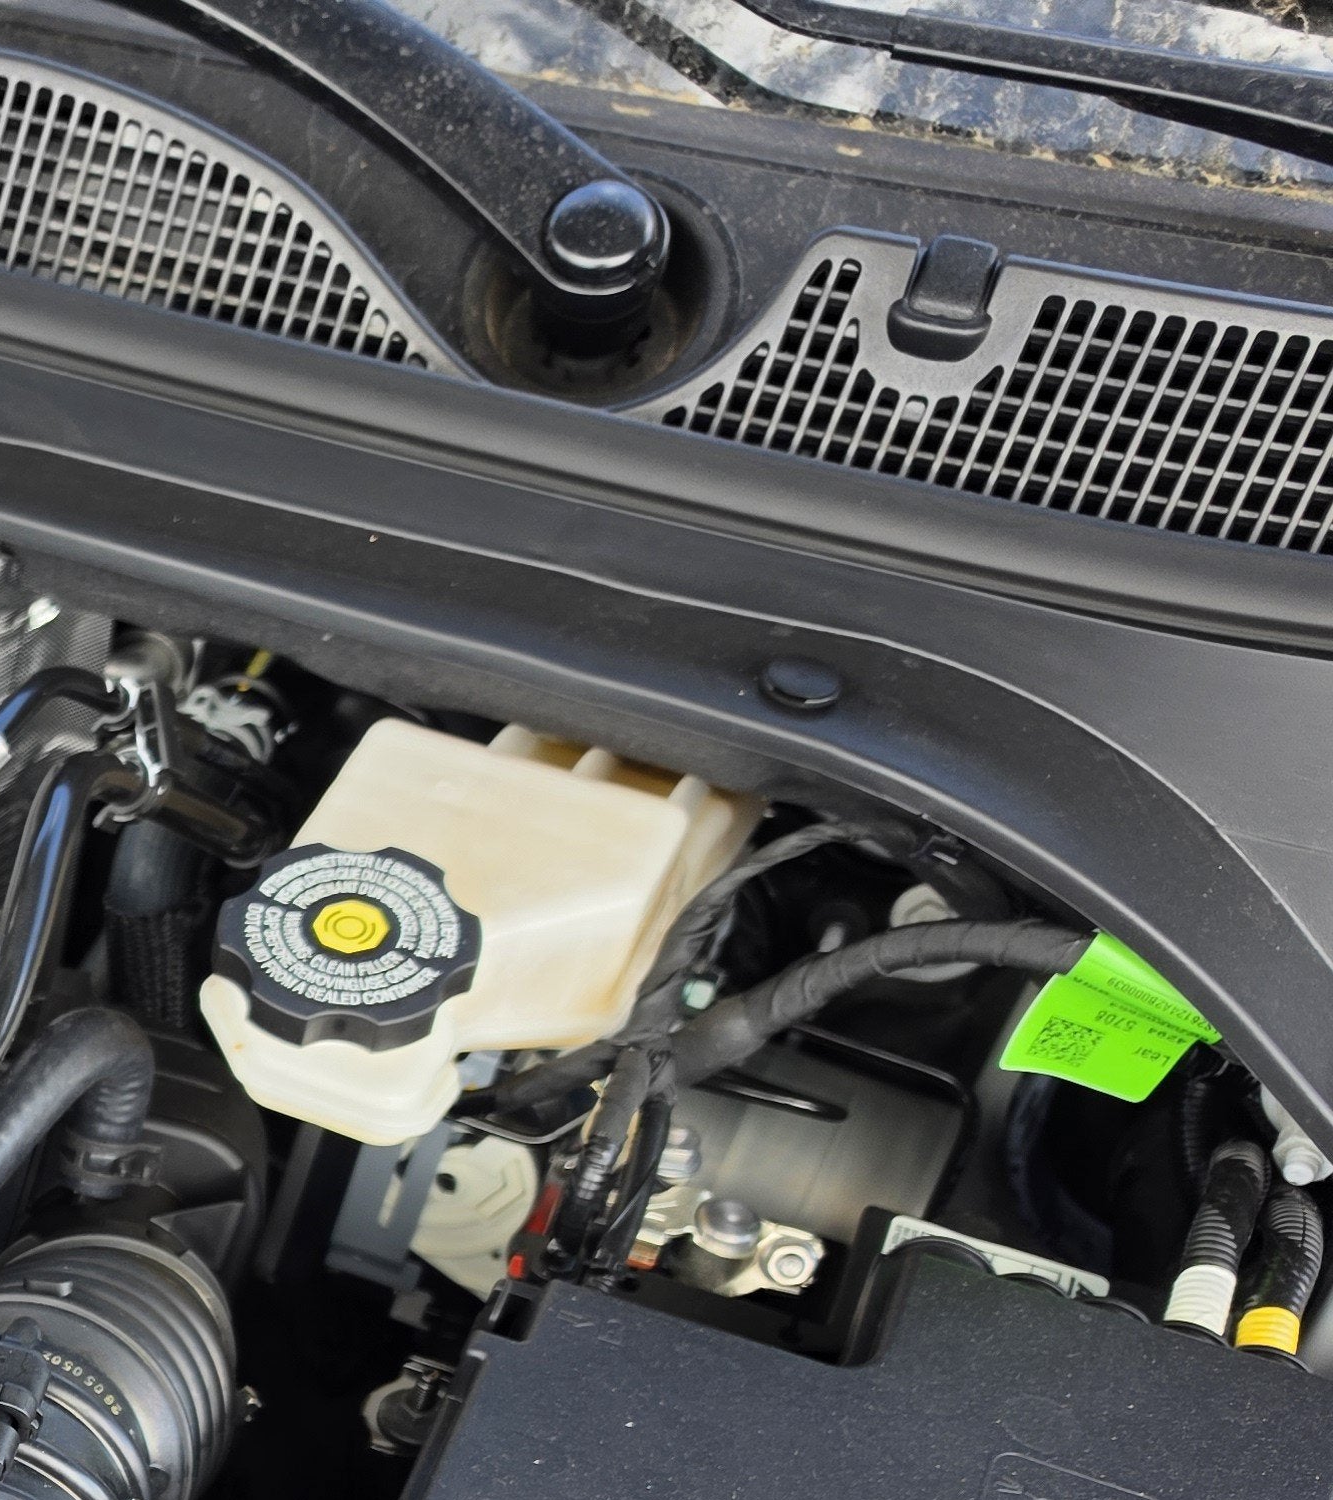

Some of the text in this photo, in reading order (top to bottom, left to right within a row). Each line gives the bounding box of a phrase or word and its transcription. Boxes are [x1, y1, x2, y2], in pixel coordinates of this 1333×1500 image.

[263, 904, 286, 928] CAP
[263, 929, 298, 968] BEFORE
[304, 953, 357, 977] CLEAN
[356, 949, 409, 977] FILLER
[384, 958, 425, 986] ONLY
[258, 959, 300, 990] FROM
[301, 984, 361, 1005] SEALED
[359, 974, 391, 992] USE
[1130, 1044, 1171, 1068] Lear
